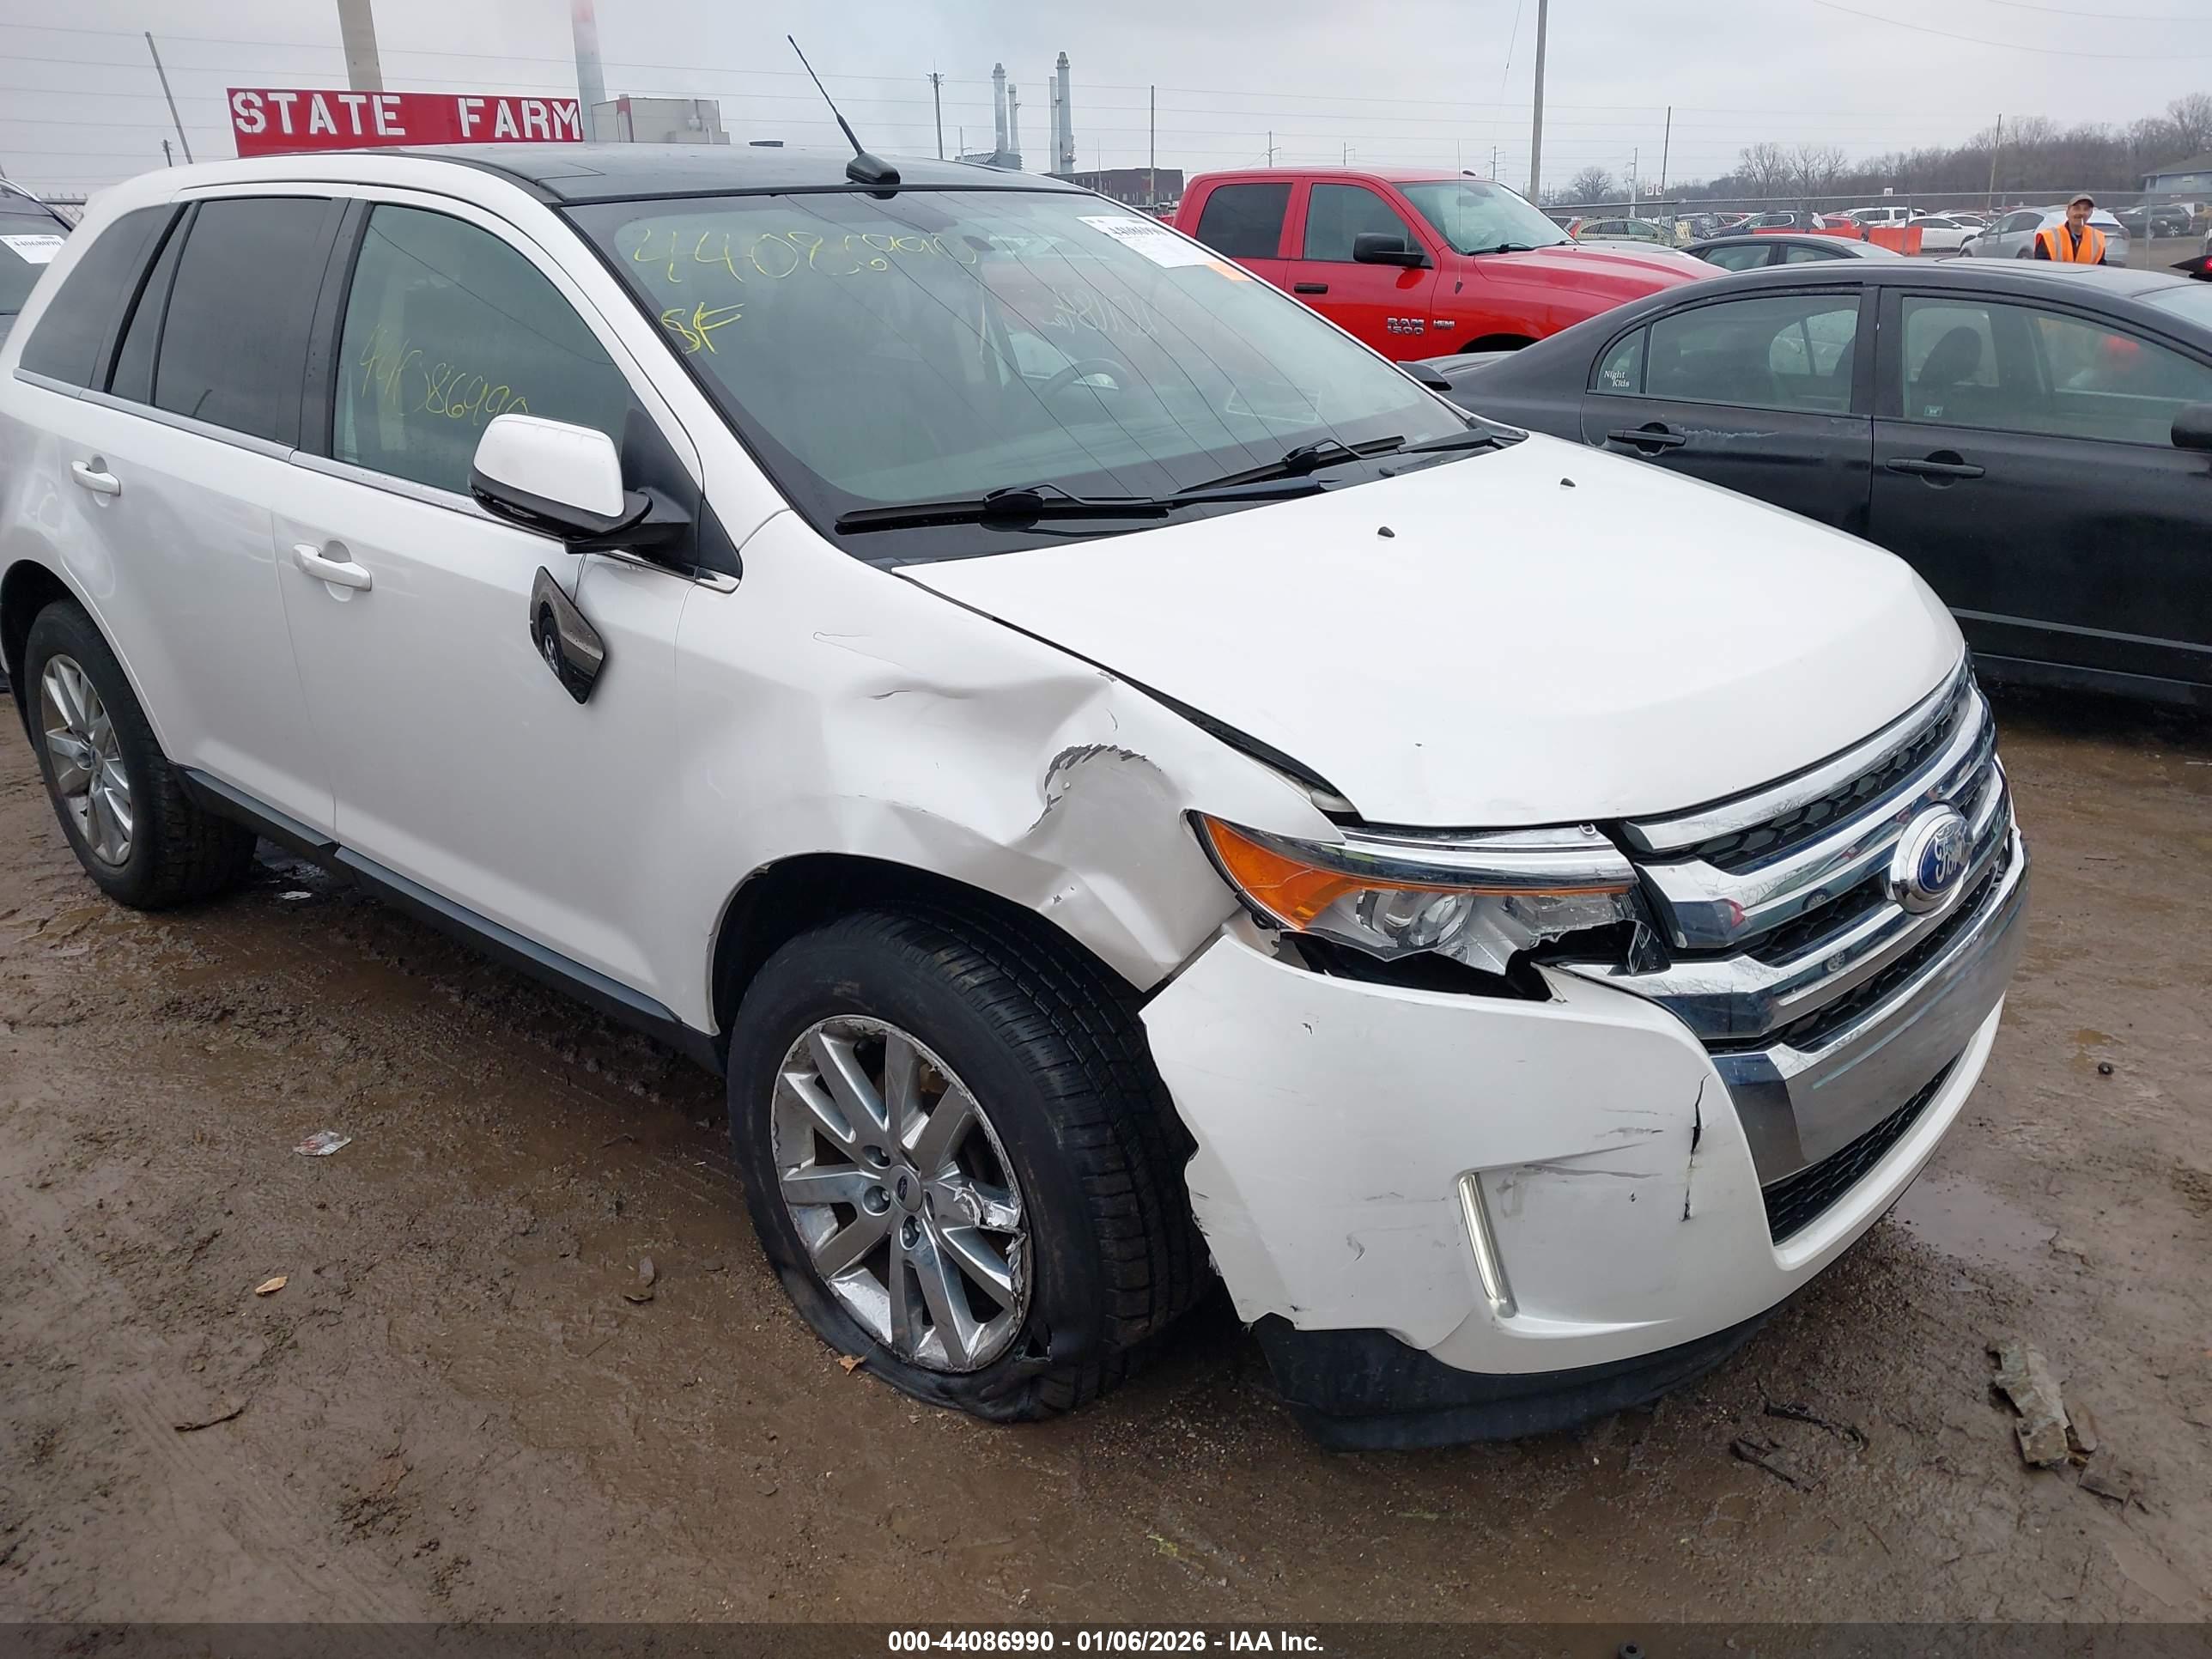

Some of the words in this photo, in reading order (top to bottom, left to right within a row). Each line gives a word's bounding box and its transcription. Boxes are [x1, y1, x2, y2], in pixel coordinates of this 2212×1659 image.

[231, 91, 405, 136] STATE
[457, 96, 580, 139] FARM
[1387, 317, 1425, 326] RAM
[1387, 325, 1425, 335] 1500
[1603, 370, 1626, 380] Night
[1612, 379, 1631, 387] Kids
[1933, 821, 1968, 884] Ford
